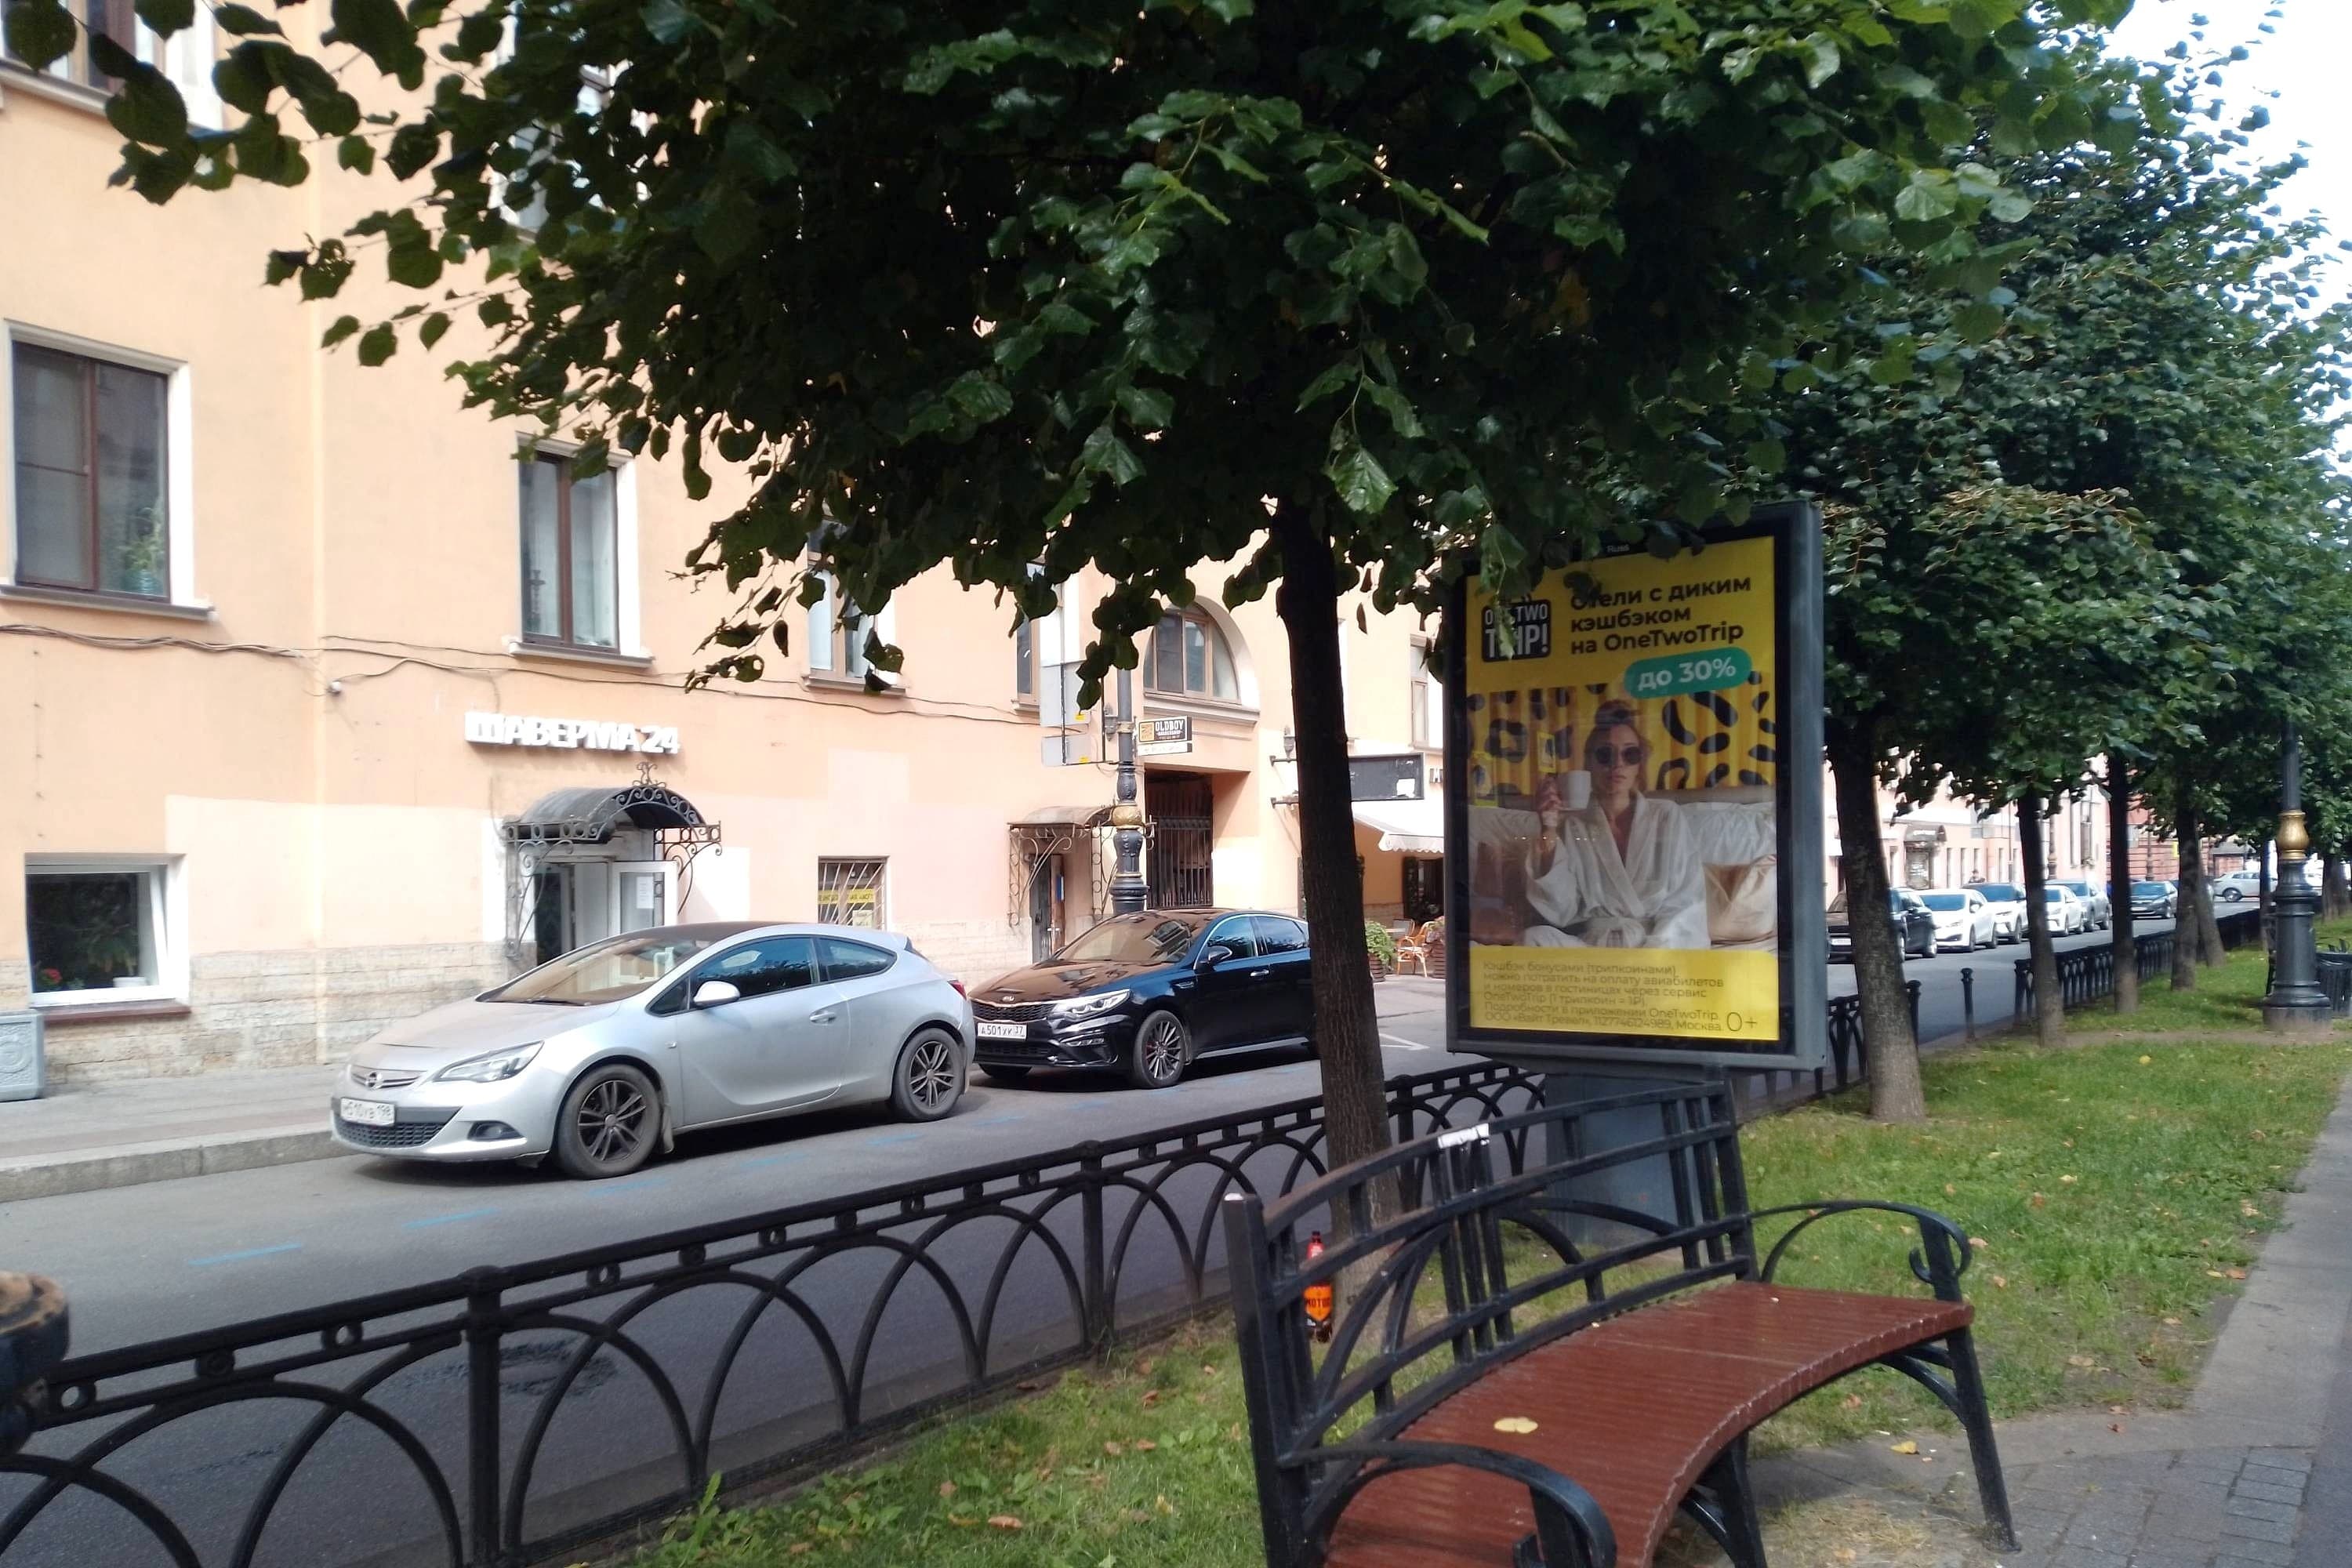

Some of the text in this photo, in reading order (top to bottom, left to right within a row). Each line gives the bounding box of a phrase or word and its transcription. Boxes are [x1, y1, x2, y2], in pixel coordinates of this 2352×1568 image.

[1570, 576, 1751, 610] Оели с диким
[1515, 604, 1548, 622] TWO
[1570, 607, 1692, 633] кэшбэком
[1484, 622, 1549, 658] TIP!
[1570, 621, 1744, 655] на OneTwoTrip
[1638, 656, 1737, 691] до 30%
[464, 712, 679, 754] ШАВЕРМА 24
[1155, 720, 1185, 731] OLDBOY
[1528, 961, 1584, 973] бонусами
[1483, 972, 1520, 981] можно
[1524, 974, 1581, 982] потратить
[1600, 975, 1640, 986] оплату
[1643, 975, 1724, 988] авиабилетов
[1483, 992, 1546, 1004] OneTwoTrip
[1494, 984, 1543, 993] номеров
[1555, 986, 1621, 996] гостиницах
[1624, 988, 1660, 998] через
[1663, 989, 1708, 1000] сервис
[1485, 1001, 1559, 1013] Подробности
[1571, 1007, 1646, 1018] приложении
